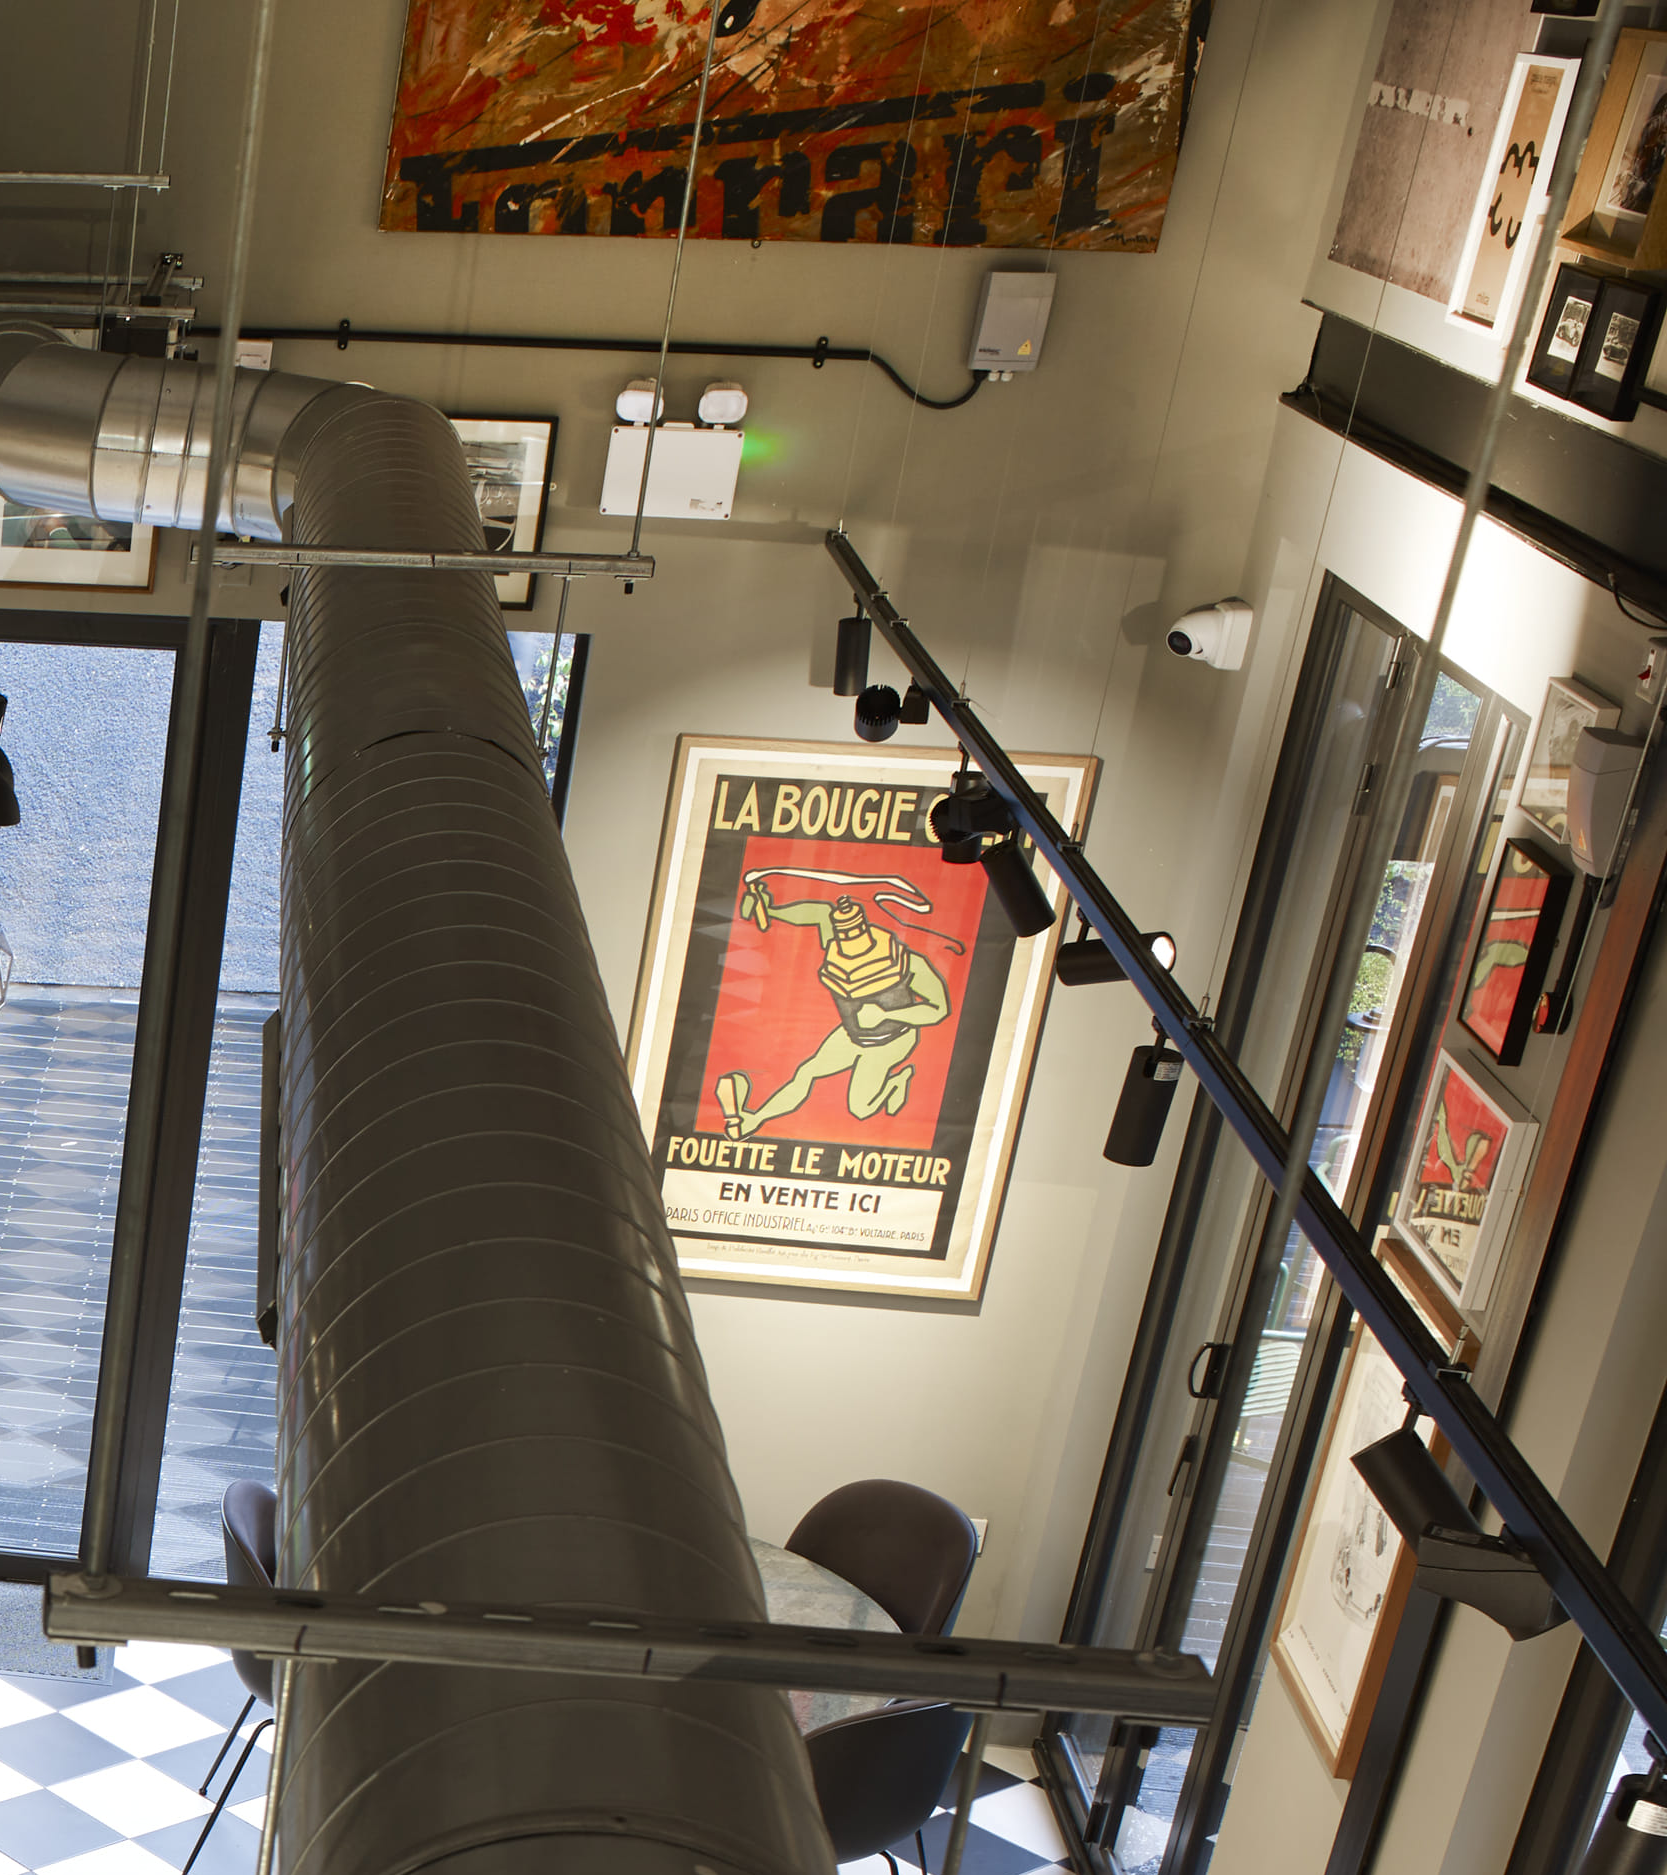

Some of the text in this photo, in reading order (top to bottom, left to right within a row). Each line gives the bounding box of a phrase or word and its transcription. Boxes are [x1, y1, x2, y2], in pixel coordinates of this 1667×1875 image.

[713, 780, 761, 832] LA
[770, 783, 918, 842] BOUGIE
[667, 1135, 951, 1186] FOUETTE LE MOTEUR
[718, 1182, 882, 1214] EN VENTE ICI
[667, 1206, 699, 1222] PARIS
[702, 1209, 740, 1226] OFFICE
[743, 1212, 806, 1232] INDUSTRIEL
[900, 1230, 925, 1242] PARIS
